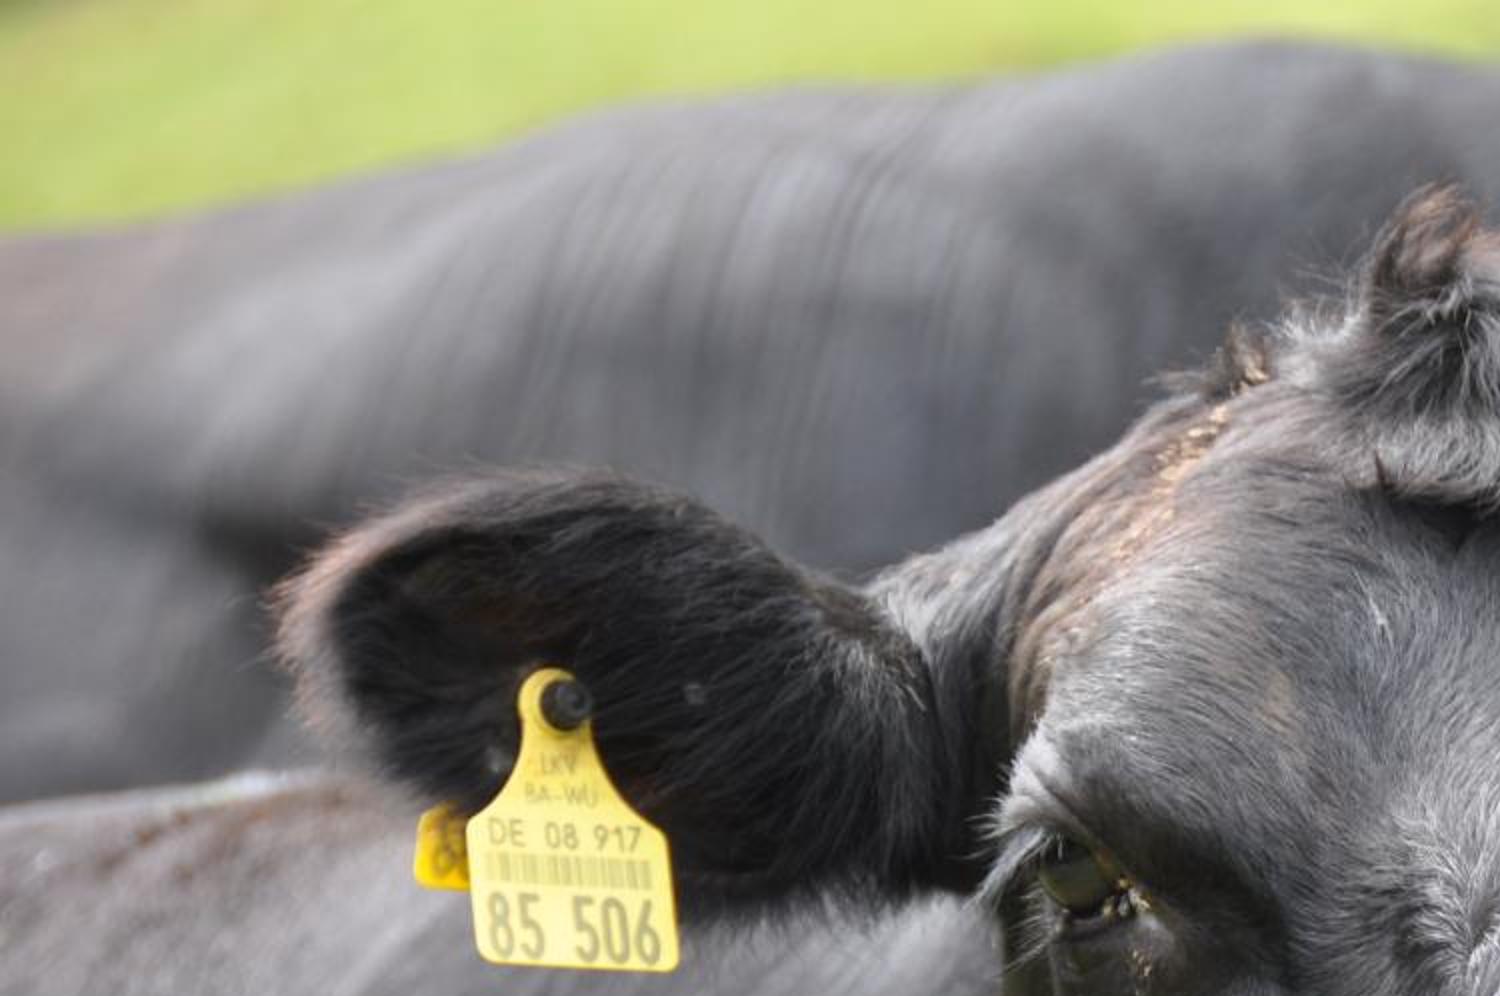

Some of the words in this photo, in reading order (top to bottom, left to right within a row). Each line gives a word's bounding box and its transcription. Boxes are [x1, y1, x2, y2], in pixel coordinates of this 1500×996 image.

[488, 816, 525, 848] DE
[544, 821, 579, 850] 08
[594, 824, 642, 853] 917
[488, 891, 546, 960] 85
[571, 894, 662, 967] 506
